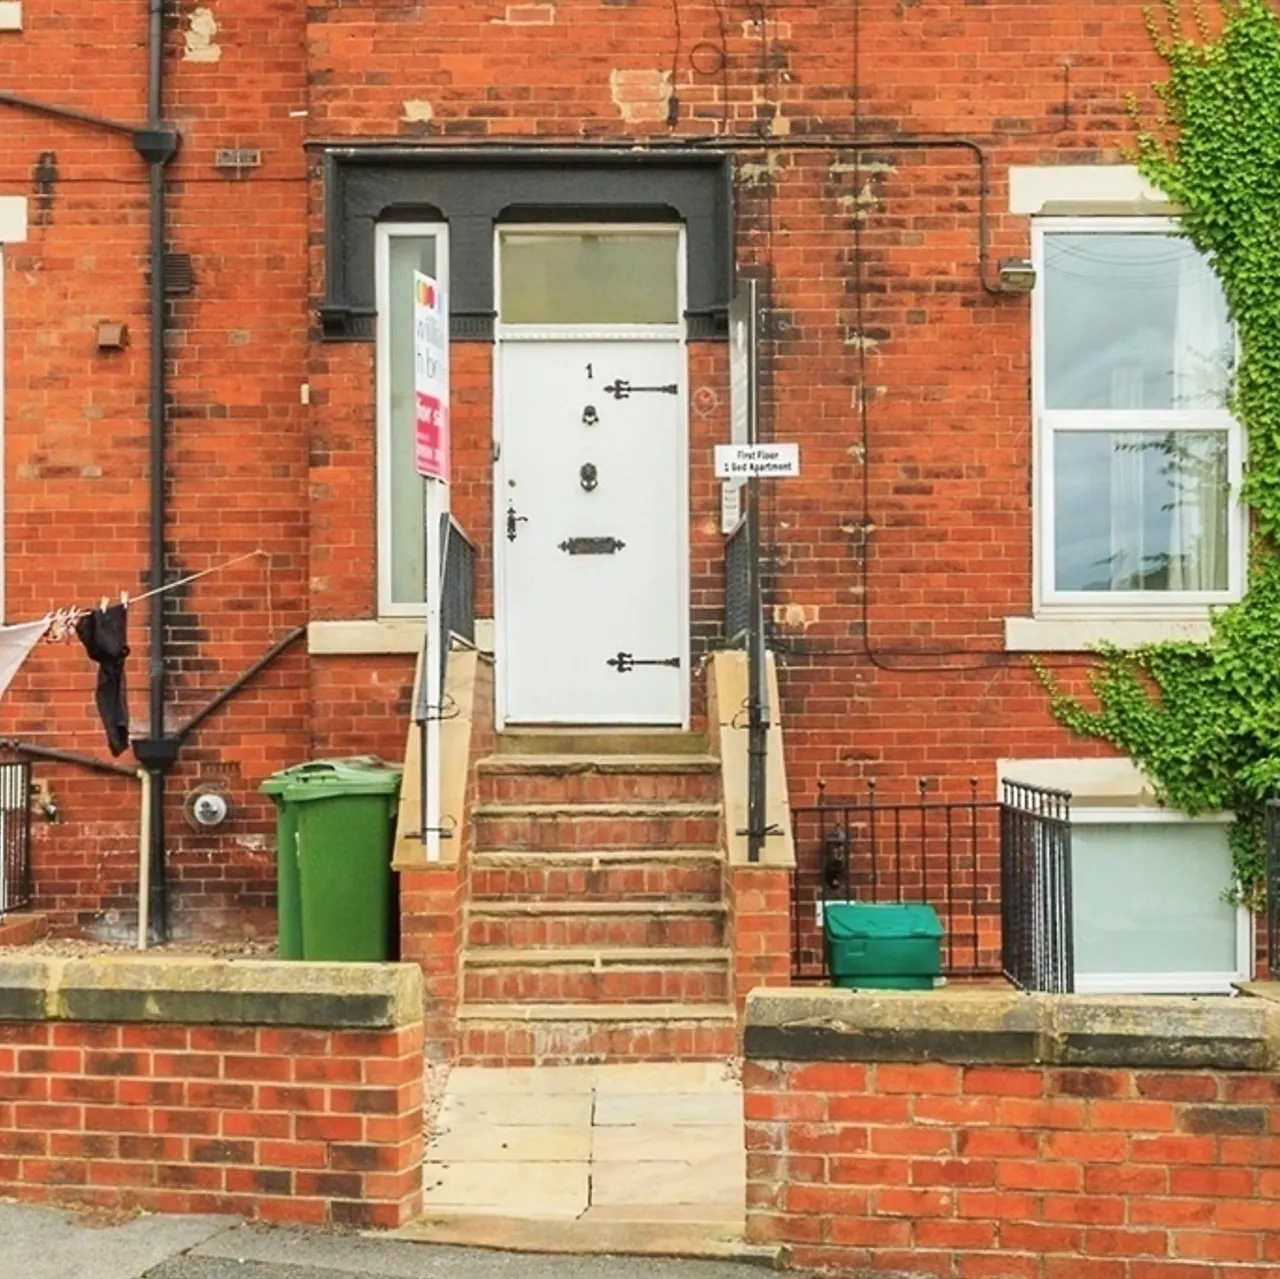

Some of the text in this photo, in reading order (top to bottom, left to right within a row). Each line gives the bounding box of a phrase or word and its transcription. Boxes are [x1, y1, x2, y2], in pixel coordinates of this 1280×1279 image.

[585, 362, 593, 379] 1
[737, 450, 779, 459] First Floor
[749, 462, 792, 473] Apartment
